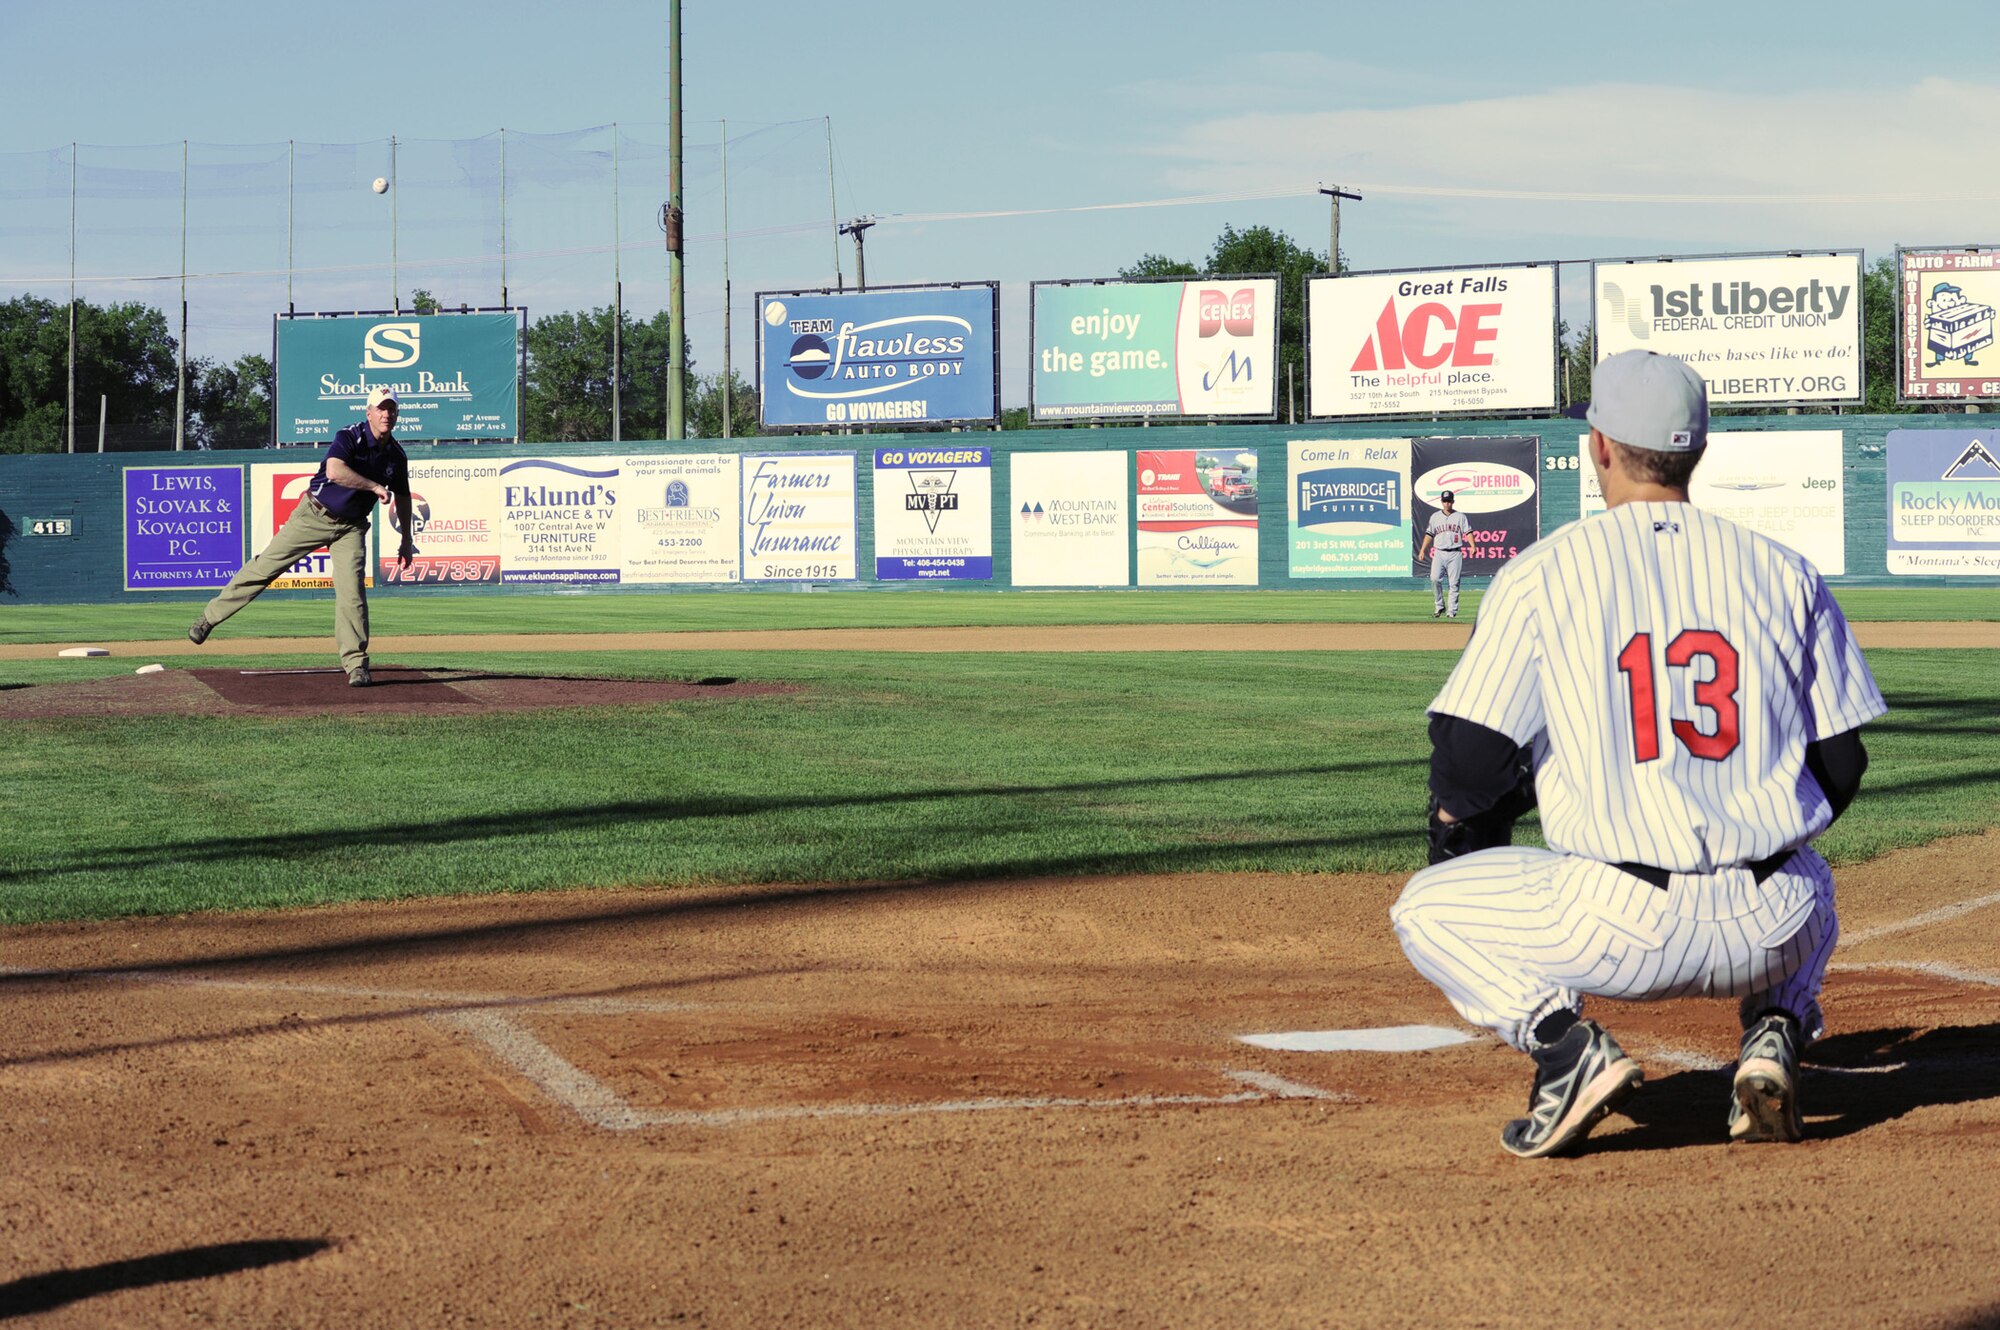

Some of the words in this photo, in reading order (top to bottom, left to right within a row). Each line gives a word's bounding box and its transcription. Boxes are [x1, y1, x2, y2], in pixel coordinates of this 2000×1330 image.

[1907, 257, 1943, 268] AUTO
[1955, 256, 1992, 268] FARM
[1399, 279, 1453, 296] Great
[1460, 276, 1508, 294] Falls
[1650, 283, 1703, 317] 1st
[1712, 279, 1850, 320] Liberty
[1200, 304, 1254, 320] CENEX
[790, 320, 834, 335] TEAM
[1071, 308, 1141, 341] enjoy
[1653, 318, 1718, 332] FEDERAL
[1724, 315, 1775, 330] CREDIT
[1782, 313, 1828, 328] UNION
[1906, 270, 1918, 380] MOTORCYCLE
[1350, 294, 1502, 372] ACE
[830, 322, 964, 380] flawless
[1726, 348, 1766, 361] bases
[1770, 346, 1798, 360] like
[1804, 348, 1822, 358] we
[1828, 346, 1852, 358] do!
[1042, 346, 1083, 373] the
[1090, 349, 1168, 378] game.
[845, 365, 898, 380] AUTO
[908, 362, 964, 376] BODY
[418, 372, 470, 392] Bank
[1351, 376, 1380, 388] The
[1386, 372, 1442, 388] helpful
[1448, 372, 1494, 386] place.
[1350, 392, 1366, 400] 3527
[1368, 391, 1382, 399] 10th
[1400, 390, 1420, 398] South
[1429, 389, 1442, 397] 215
[1444, 388, 1480, 396] Northwest
[1482, 386, 1508, 396] Bypass
[1907, 383, 1929, 394] JET
[1936, 382, 1960, 394] SKI
[826, 403, 846, 421] GO
[848, 400, 927, 420] VOYAGERS!
[1040, 402, 1176, 416] www.mountainviewcoop.com
[882, 453, 904, 464] GO
[908, 451, 982, 464] VOYAGERS
[1301, 449, 1335, 462] Come
[1338, 449, 1349, 460] In
[1365, 448, 1398, 460] Relax
[626, 458, 693, 468] Compassionate
[1546, 456, 1579, 470] 368
[408, 466, 497, 481] disefencing.com
[636, 468, 656, 476] your
[659, 466, 682, 474] small
[686, 466, 721, 474] animals
[152, 474, 217, 492] LEWIS,
[749, 461, 831, 497] Farmers
[1802, 476, 1836, 490] Jeep
[504, 486, 616, 507] Eklund's
[1310, 482, 1386, 498] STAYBRIDGE
[136, 498, 213, 514] SLOVAK
[218, 498, 232, 512] &
[908, 495, 926, 509] MV
[940, 494, 956, 508] PT
[1049, 500, 1117, 512] MOUNTAIN
[1142, 502, 1214, 512] CentralSolutions
[1322, 504, 1374, 513] SUITES
[1901, 491, 1960, 514] Rocky
[507, 510, 581, 521] APPLIANCE
[584, 510, 594, 520] &
[598, 510, 614, 519] TV
[748, 492, 806, 526] Union
[414, 519, 488, 531] PARADISE
[1048, 513, 1080, 525] WEST
[1084, 512, 1117, 524] BANK
[1901, 514, 1934, 526] SLEEP
[1938, 514, 2000, 526] DISORDERS
[34, 521, 65, 534] 415
[136, 520, 232, 536] KOVACICH
[514, 524, 536, 532] 1007
[538, 522, 571, 532] Central
[574, 523, 594, 531] Ave
[596, 522, 606, 530] W
[469, 534, 488, 542] INC
[523, 533, 597, 544] FURNITURE
[658, 538, 702, 546] 453-2200
[750, 521, 841, 556] Insurance
[1296, 541, 1311, 550] 201
[1313, 540, 1328, 550] 3rd
[1330, 540, 1338, 550] St
[1340, 540, 1357, 550] NW,
[1358, 540, 1380, 549] Great
[1382, 540, 1404, 549] Falls
[168, 540, 201, 556] P.C.
[528, 544, 544, 552] 314
[548, 544, 562, 552] 1st
[564, 544, 582, 552] Ave
[585, 544, 592, 552] N
[892, 548, 934, 556] PHYSICAL
[936, 547, 974, 556] THERAPY
[1178, 536, 1239, 556] Culligan
[1488, 546, 1506, 558] ST.
[514, 555, 539, 564] Serving
[540, 554, 570, 562] Montana
[917, 558, 965, 566] 406-454-0438
[1320, 553, 1378, 562] 406.761.4903
[132, 570, 192, 580] ATTORNEYS
[195, 568, 211, 578] AT
[384, 560, 496, 582] 727-7337
[504, 571, 618, 583] www.eklundsappliance.com
[764, 565, 803, 578] Since
[806, 564, 838, 578] 1915
[918, 569, 950, 578] mvpt.net
[1618, 629, 1740, 764] 13
